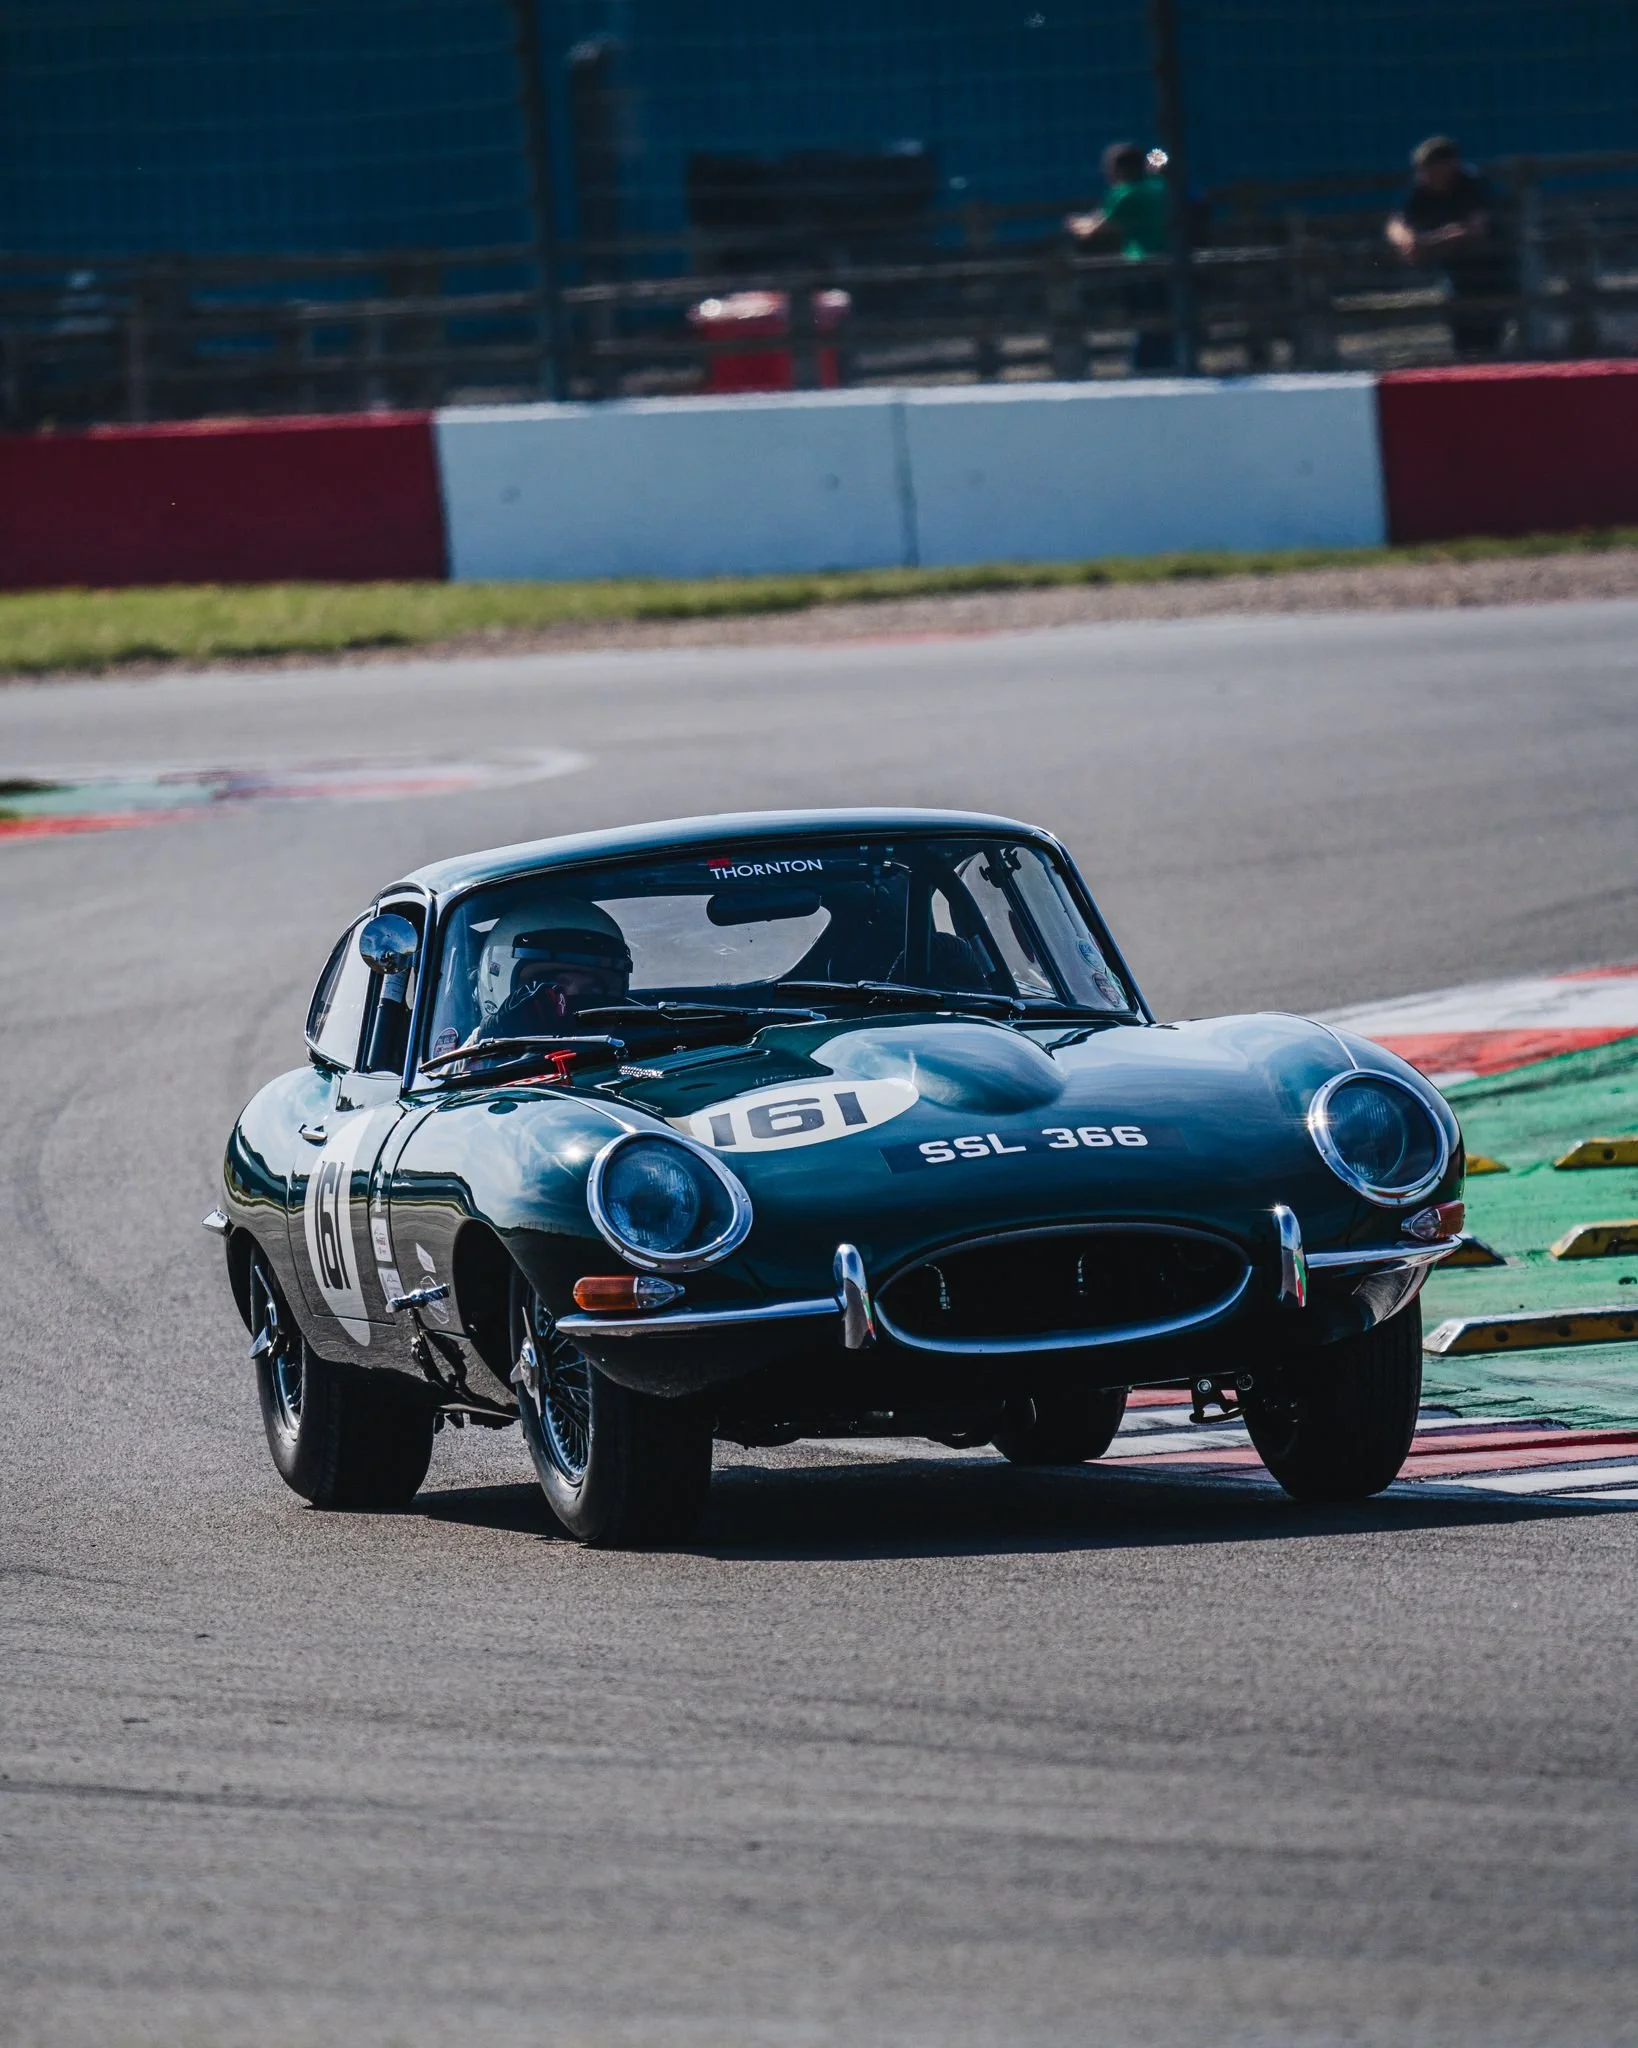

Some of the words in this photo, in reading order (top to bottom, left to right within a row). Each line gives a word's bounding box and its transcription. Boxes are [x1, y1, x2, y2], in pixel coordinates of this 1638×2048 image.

[711, 859, 823, 879] THORNTON
[711, 1091, 868, 1147] 161
[919, 1133, 1026, 1165] SSL
[1041, 1126, 1148, 1150] 366
[315, 1161, 351, 1289] 161
